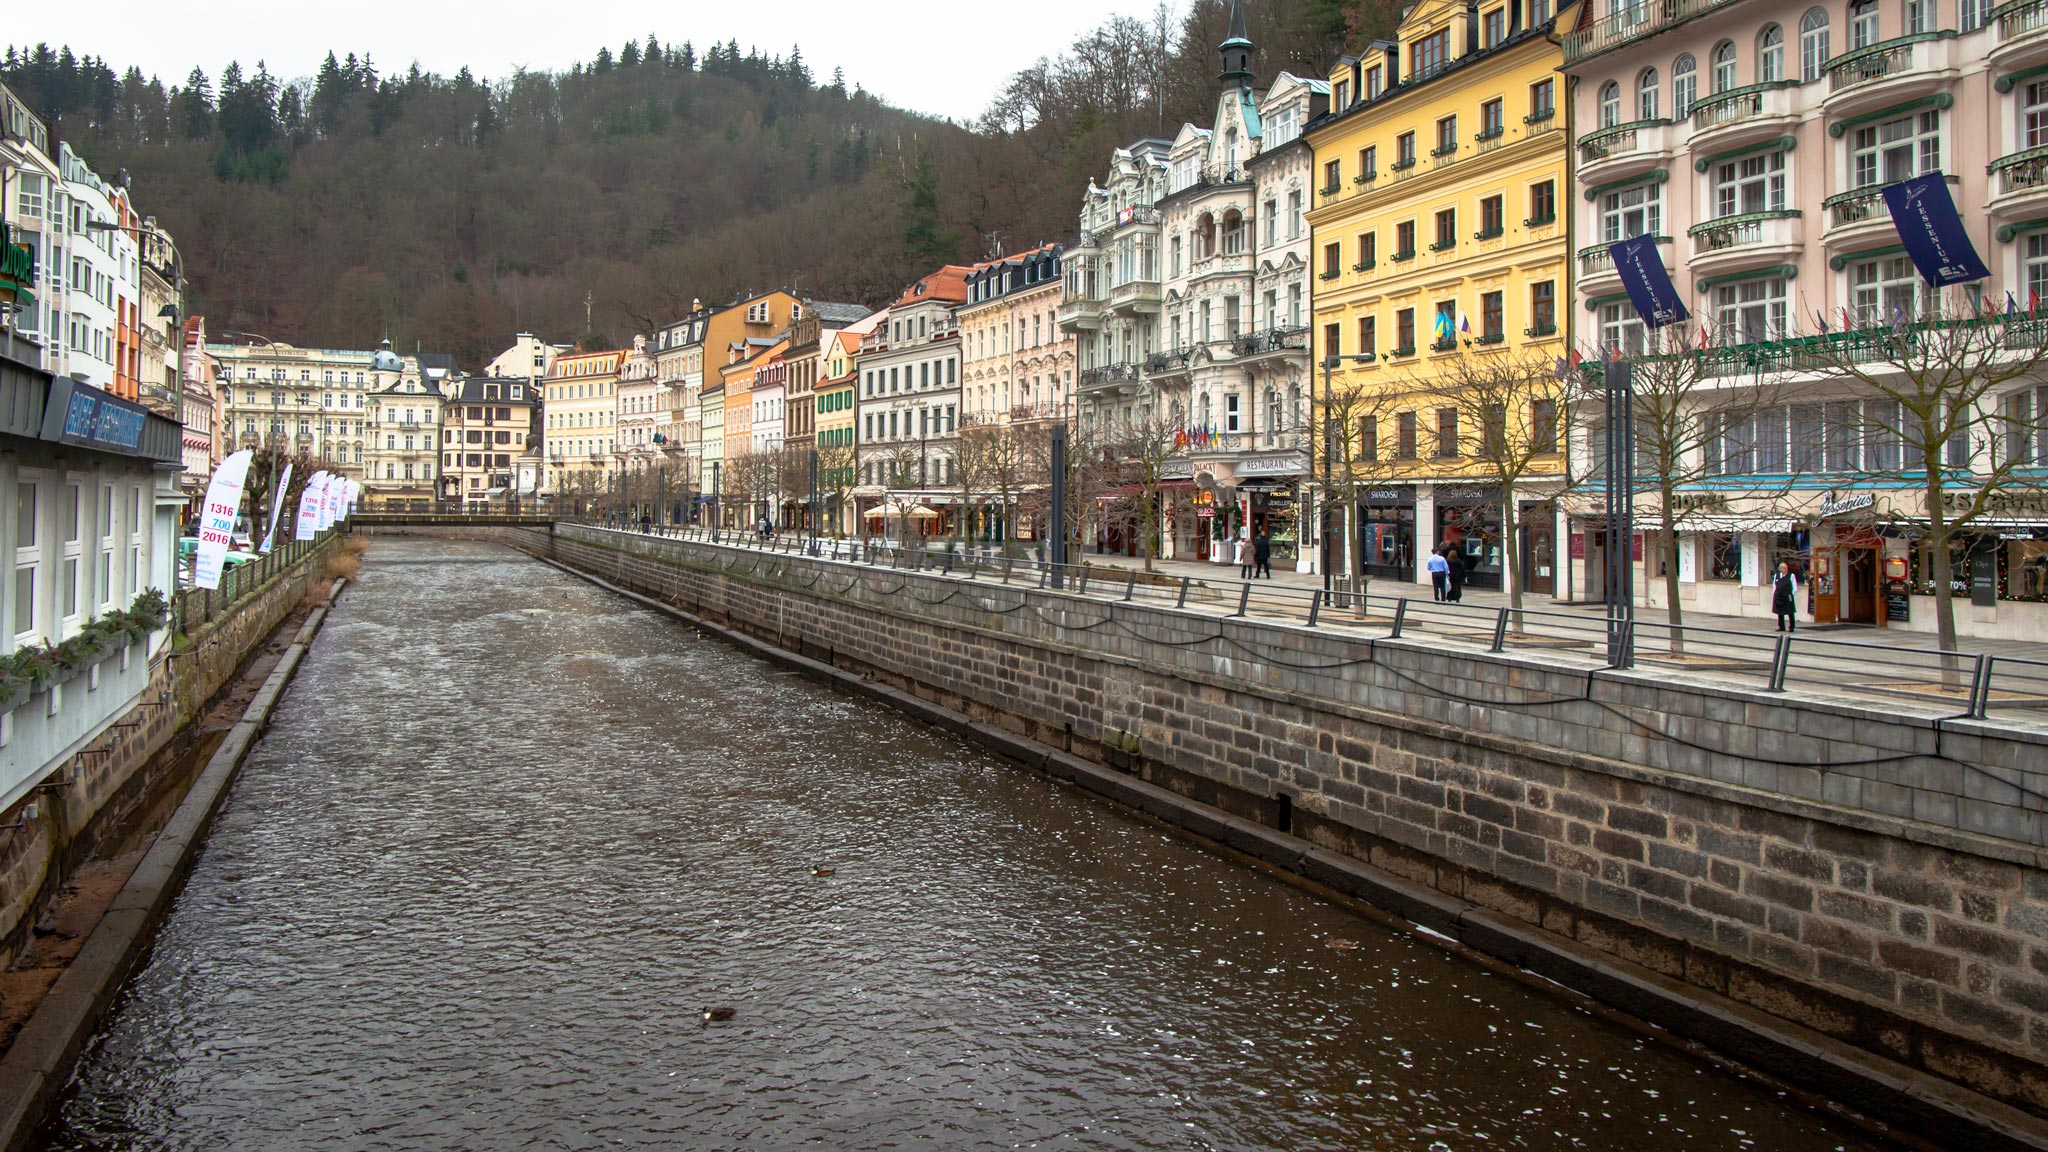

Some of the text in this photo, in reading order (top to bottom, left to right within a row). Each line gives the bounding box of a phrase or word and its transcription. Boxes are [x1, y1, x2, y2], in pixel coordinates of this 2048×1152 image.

[1917, 200, 1950, 263] JESSENIUS
[1246, 460, 1288, 470] RESTAURANT
[1371, 491, 1399, 499] SWAROVSKI
[210, 503, 233, 517] 1316
[212, 518, 231, 531] 700
[202, 531, 229, 545] 2016
